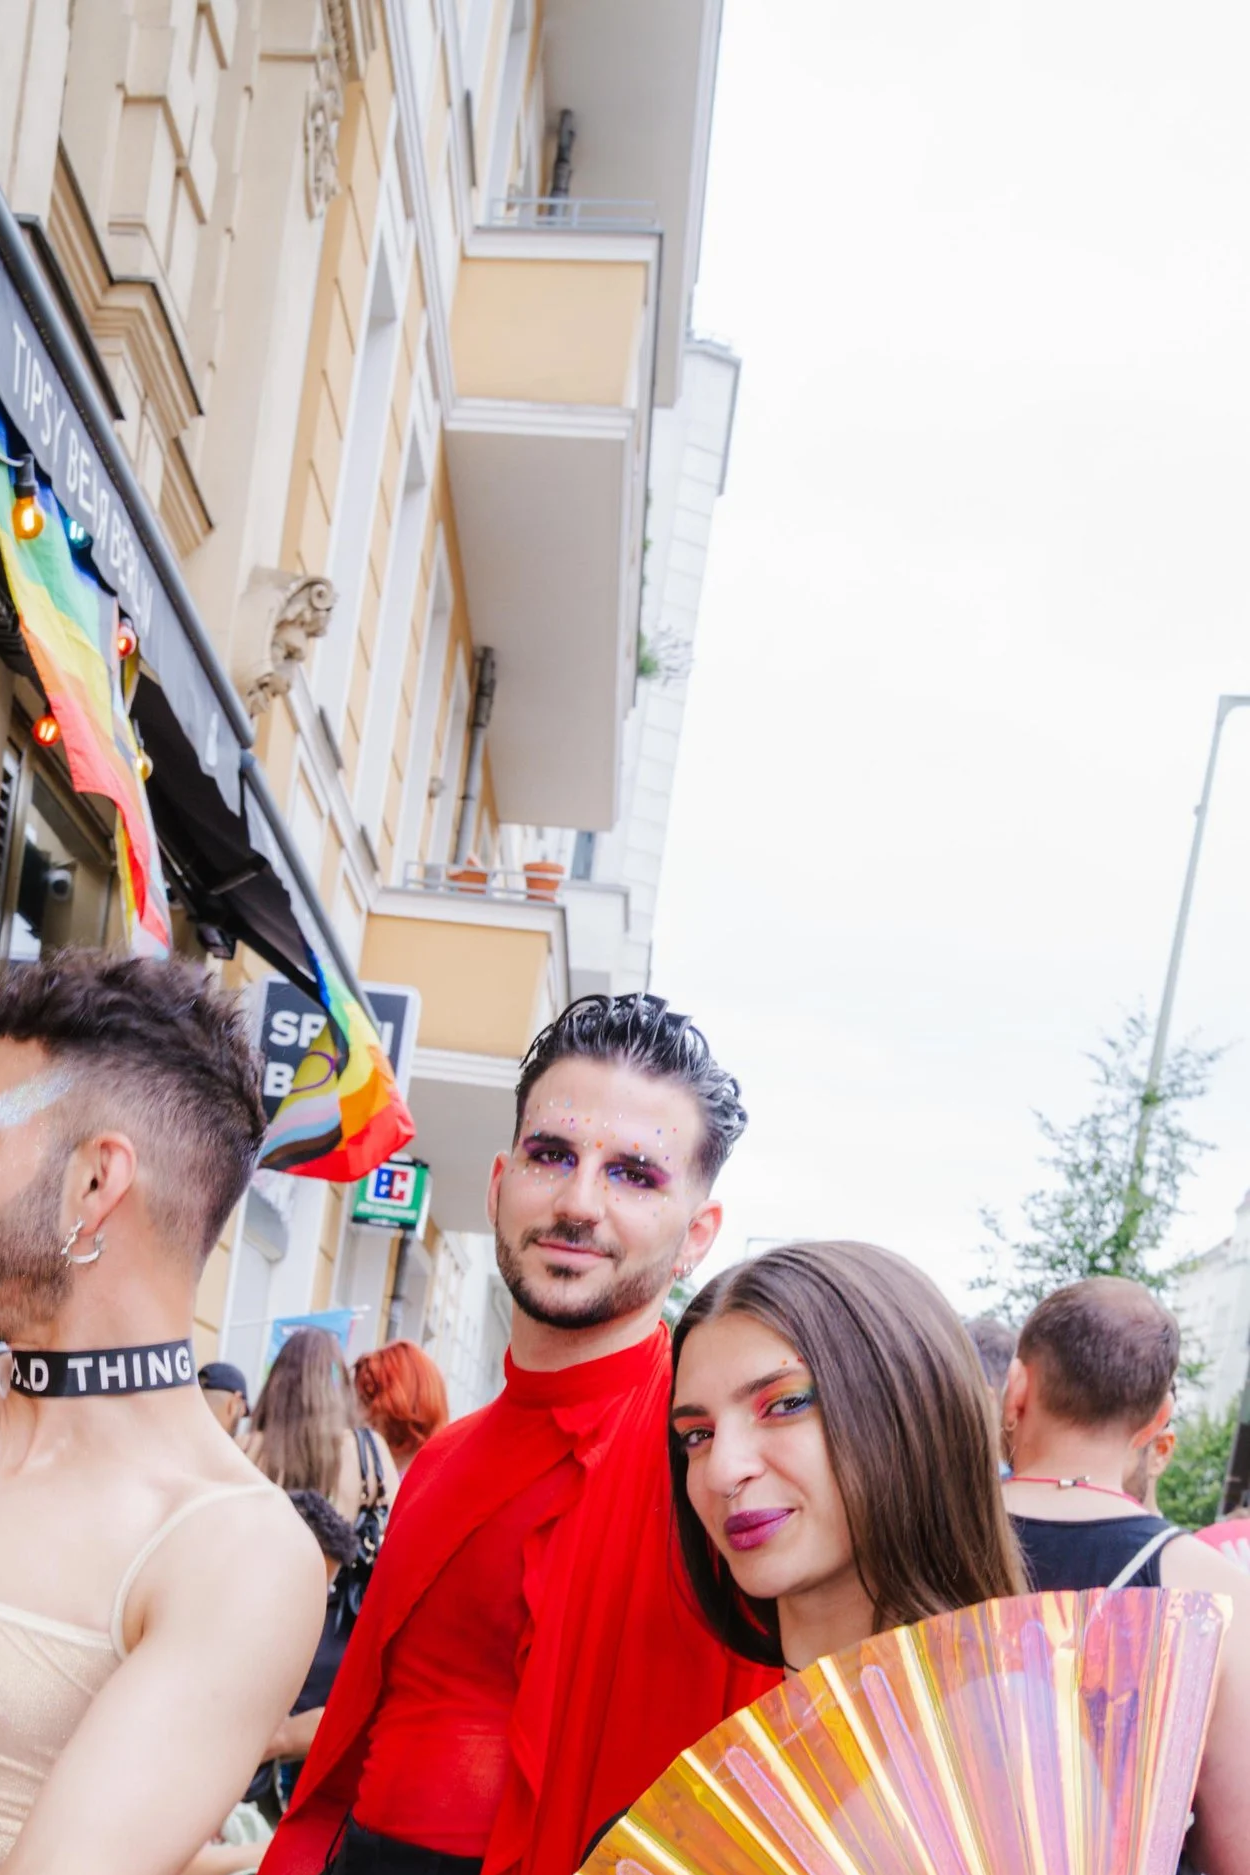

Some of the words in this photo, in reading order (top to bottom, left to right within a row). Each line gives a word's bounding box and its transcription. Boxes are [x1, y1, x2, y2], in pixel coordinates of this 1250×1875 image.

[12, 320, 67, 465] TIPSY
[268, 1010, 395, 1058] SPI
[67, 1346, 192, 1392] THING
